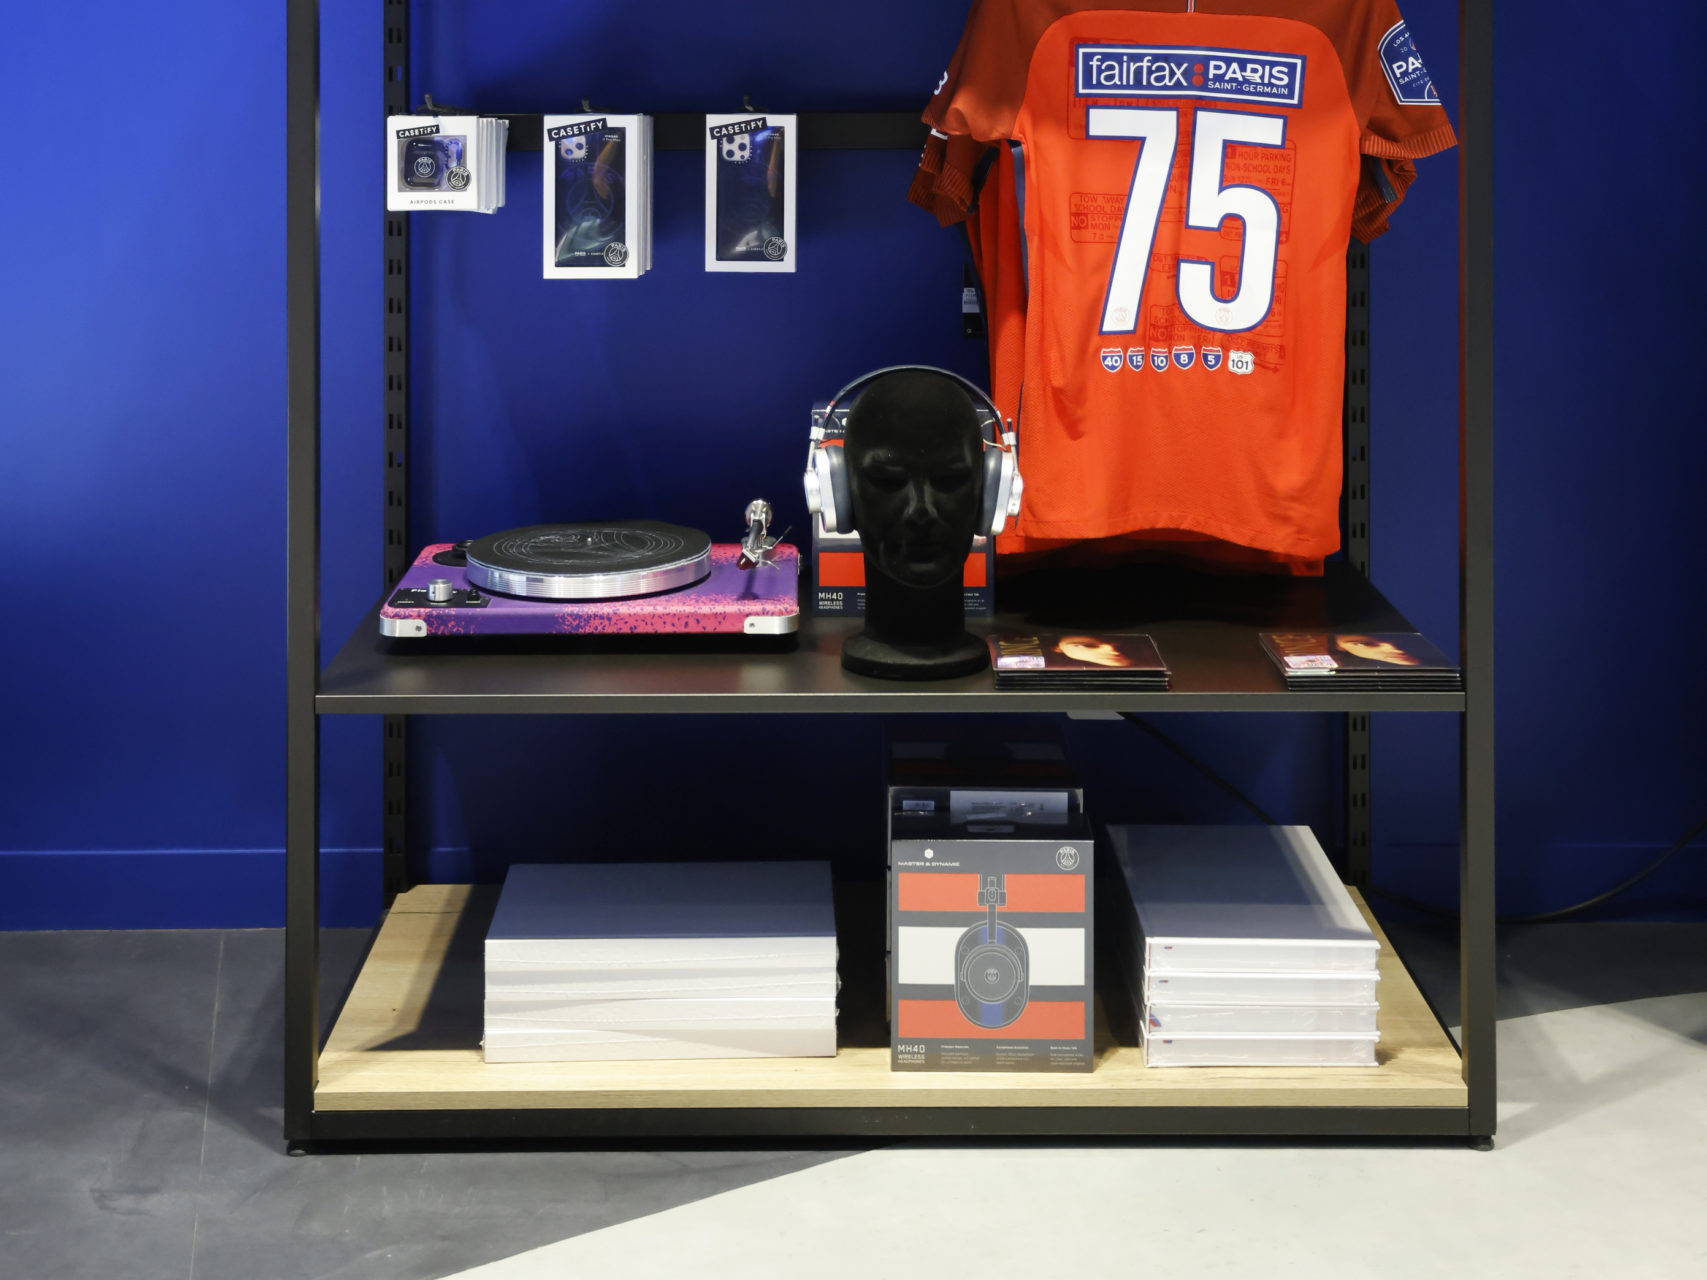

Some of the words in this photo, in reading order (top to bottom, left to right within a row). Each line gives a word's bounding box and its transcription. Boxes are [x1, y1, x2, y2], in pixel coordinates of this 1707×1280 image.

[1089, 55, 1188, 86] fairfax
[1392, 56, 1423, 78] PA
[1208, 60, 1289, 85] PARIS
[1261, 152, 1291, 162] PARKING
[1073, 204, 1106, 213] SCHOOL
[1071, 215, 1087, 227] NO
[1086, 104, 1288, 335] 75
[1090, 222, 1111, 231] MON
[1104, 356, 1120, 367] 40
[1132, 355, 1142, 366] 15
[1153, 356, 1166, 366] 10
[1180, 355, 1188, 364] 8
[1207, 355, 1215, 365] 5
[1231, 359, 1249, 370] 101
[818, 592, 843, 600] MH40
[897, 1044, 926, 1053] MH40
